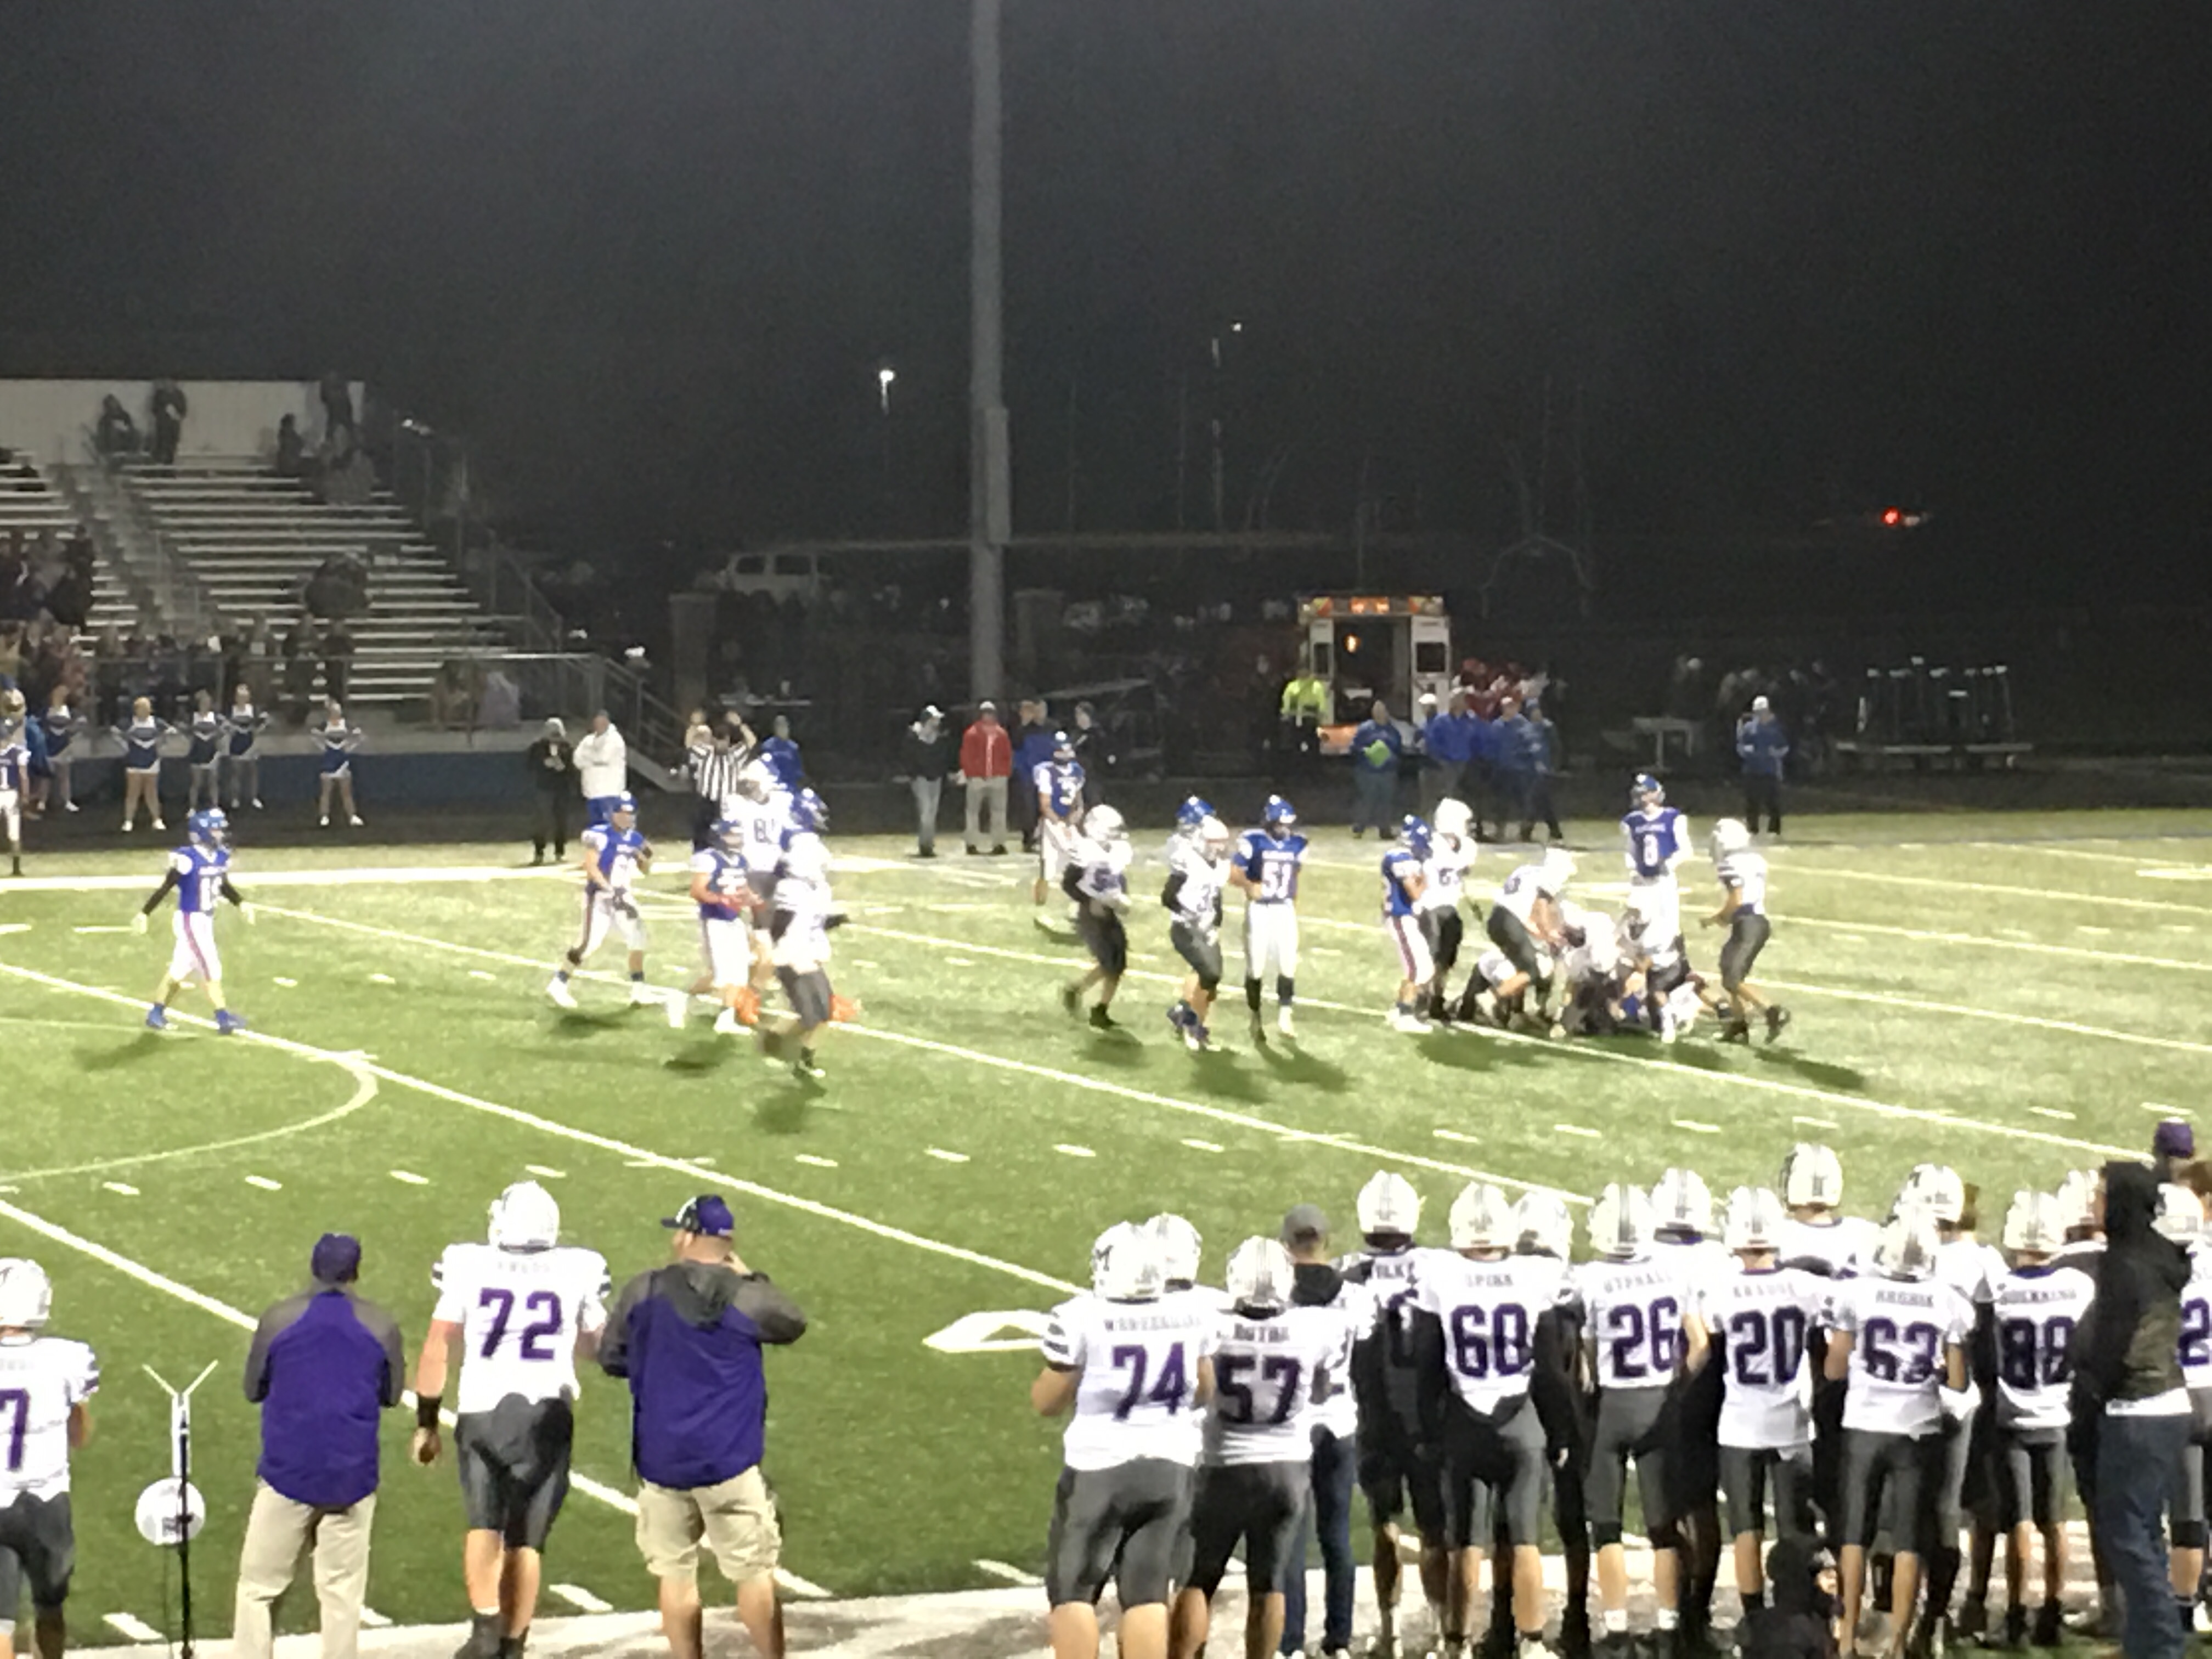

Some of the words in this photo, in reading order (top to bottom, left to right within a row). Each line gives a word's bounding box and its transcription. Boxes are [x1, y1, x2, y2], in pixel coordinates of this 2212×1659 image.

[479, 1287, 563, 1360] 72
[1608, 1296, 1690, 1378] 26
[1731, 1305, 1805, 1386] 20
[2179, 1297, 2211, 1367] 2
[1113, 1342, 1186, 1420] 74
[1214, 1355, 1302, 1425] 57
